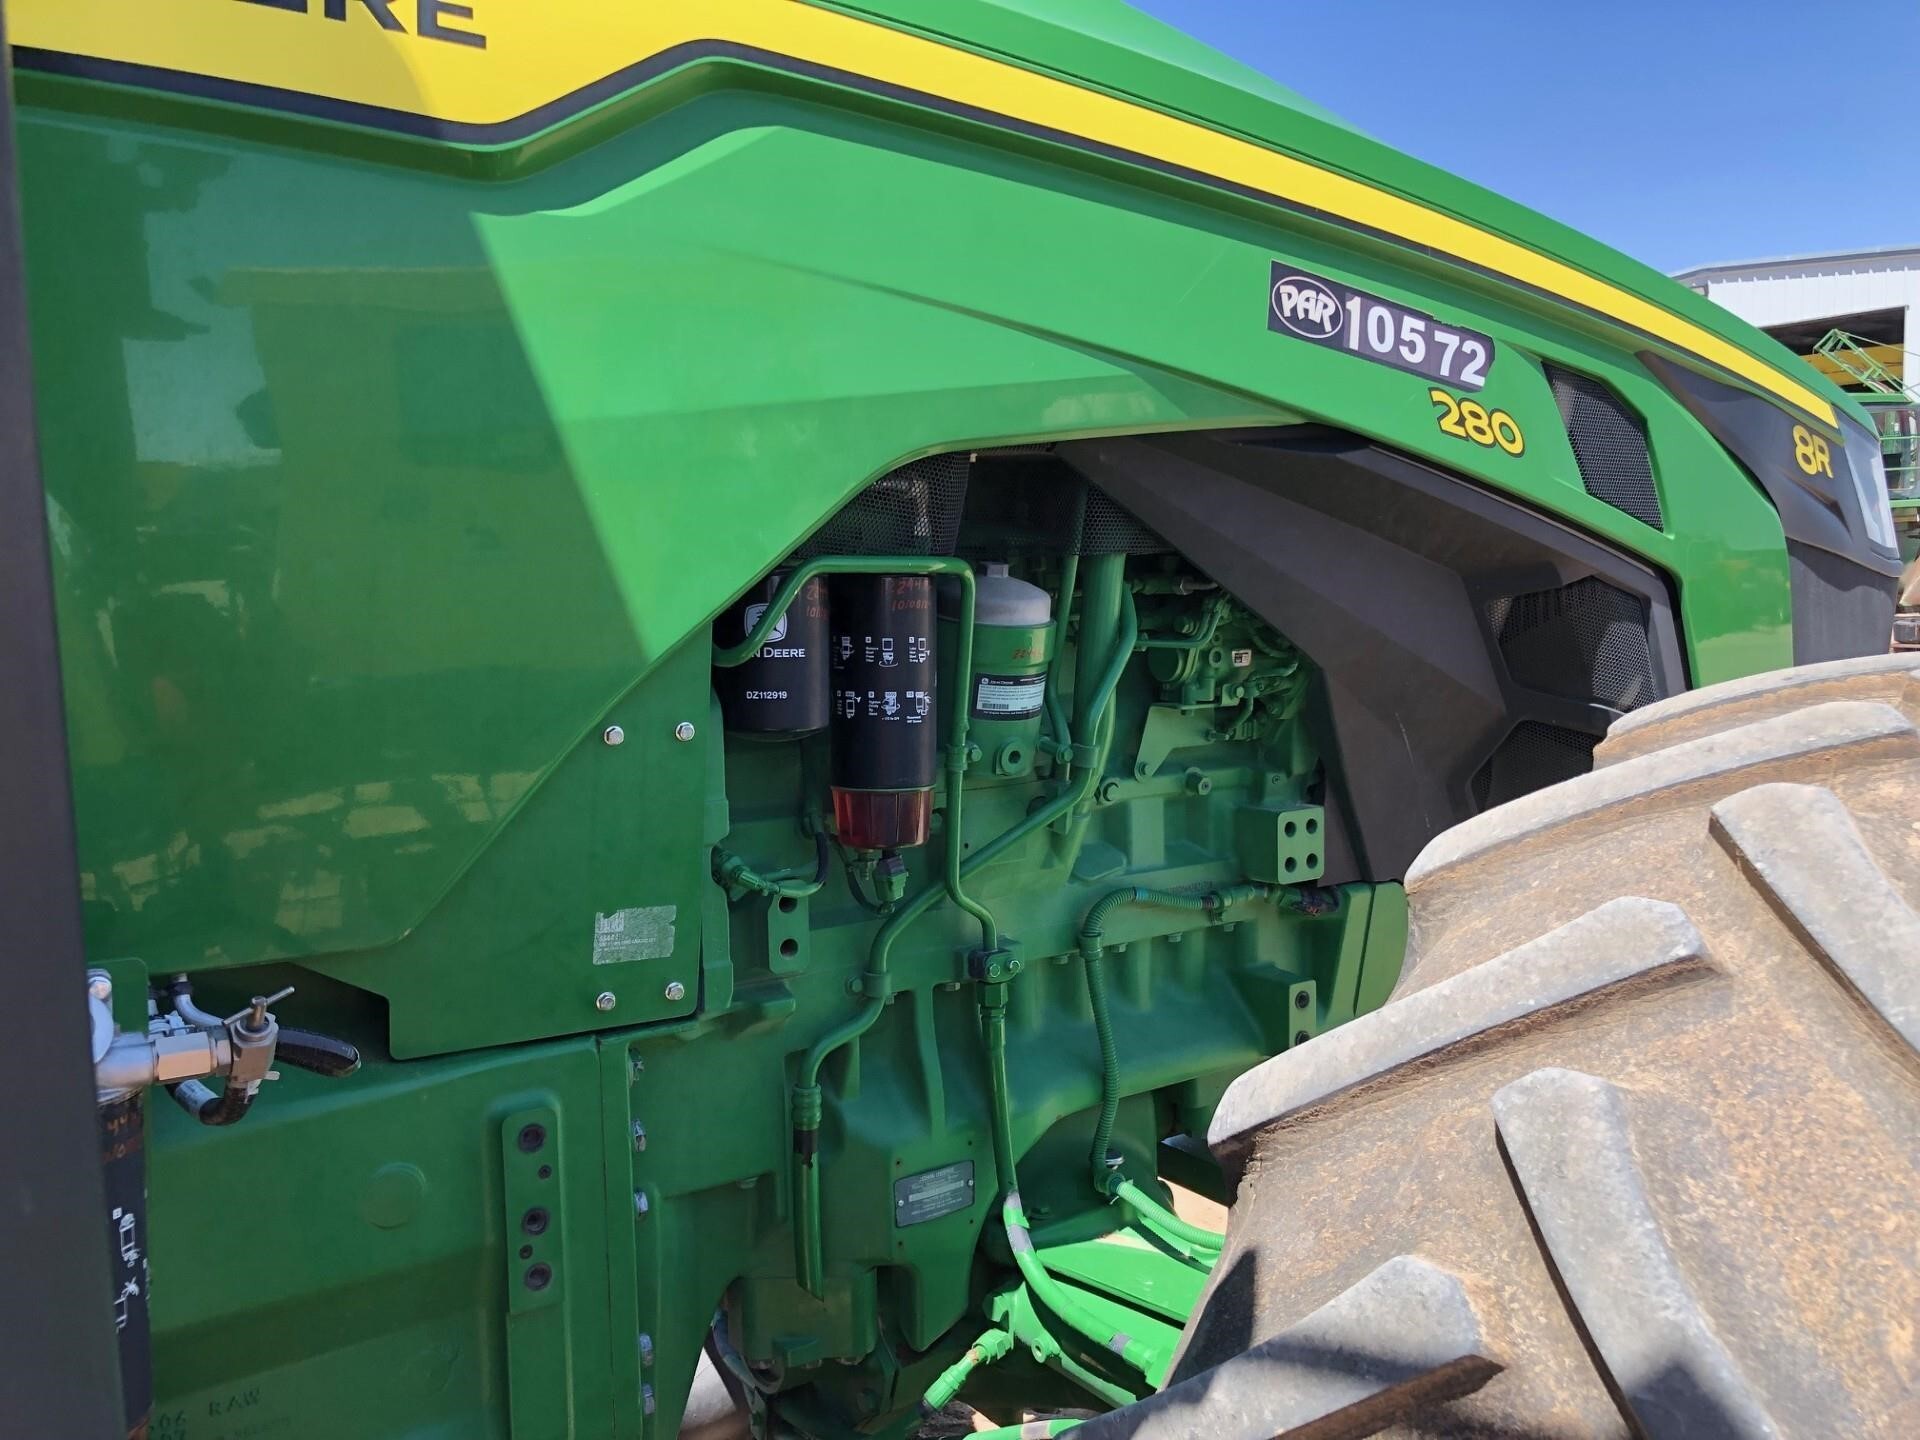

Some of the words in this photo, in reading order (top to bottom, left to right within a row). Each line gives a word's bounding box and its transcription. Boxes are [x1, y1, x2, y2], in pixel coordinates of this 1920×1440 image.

[1279, 284, 1336, 333] PAR
[1345, 296, 1486, 387] 10572
[1428, 387, 1525, 458] 280
[1792, 425, 1834, 479] 8R
[763, 647, 806, 658] DEERE
[746, 690, 788, 700] DZ112919
